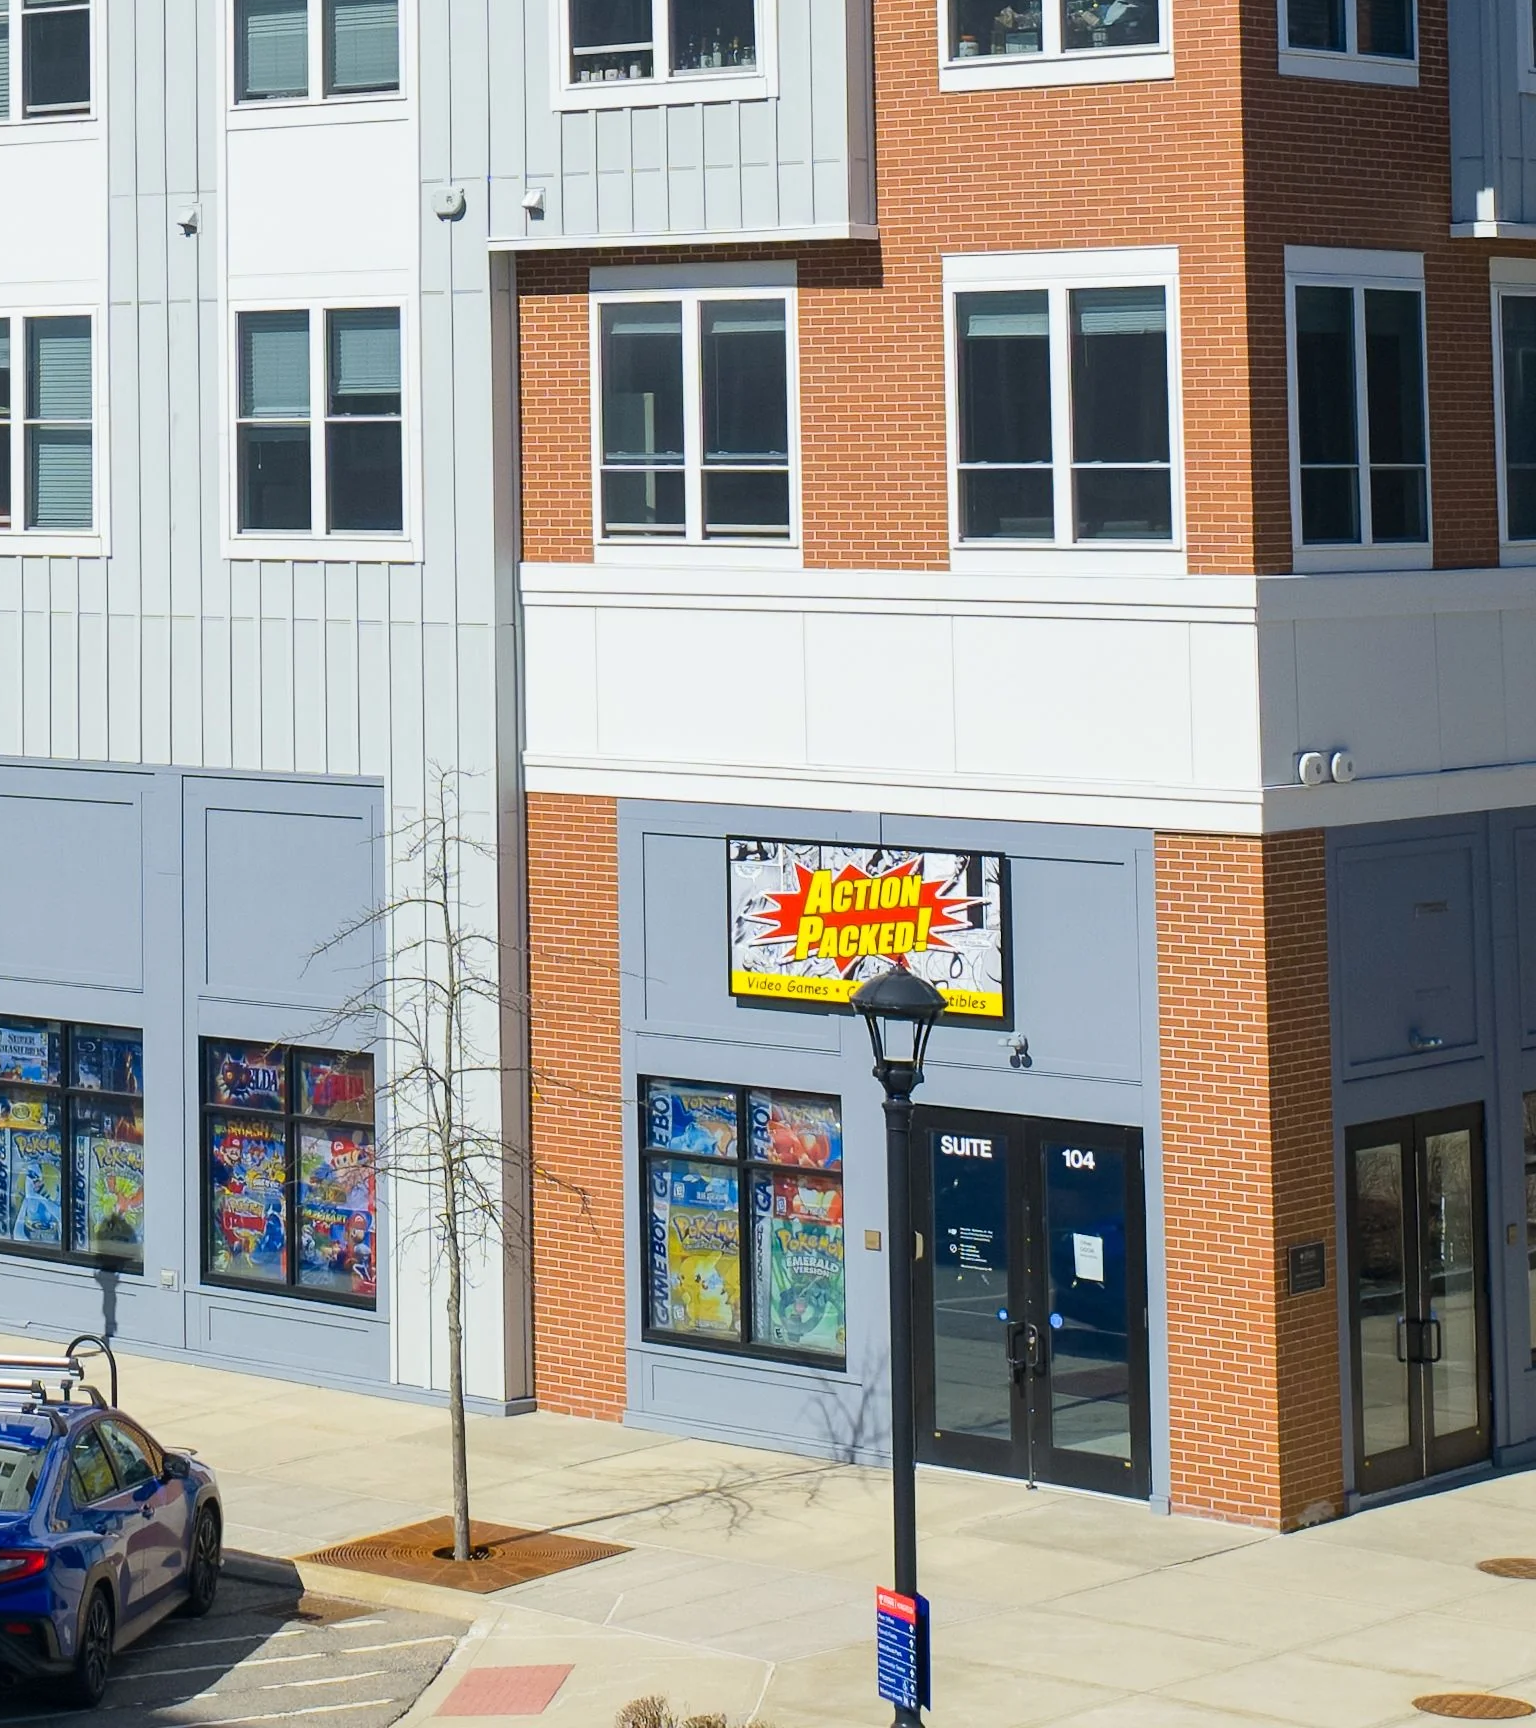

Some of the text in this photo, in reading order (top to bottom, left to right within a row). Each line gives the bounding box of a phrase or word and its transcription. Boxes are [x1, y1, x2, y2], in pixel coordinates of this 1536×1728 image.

[803, 868, 923, 915] ACTION
[794, 907, 933, 961] PACKED!
[747, 976, 782, 992] Video
[787, 979, 829, 996] Games
[941, 1135, 1096, 1170] SUITE 104
[76, 1170, 86, 1201] BOY
[653, 1212, 670, 1325] GAME BOY
[786, 1255, 840, 1273] EMERALD
[793, 1265, 830, 1278] VERSION
